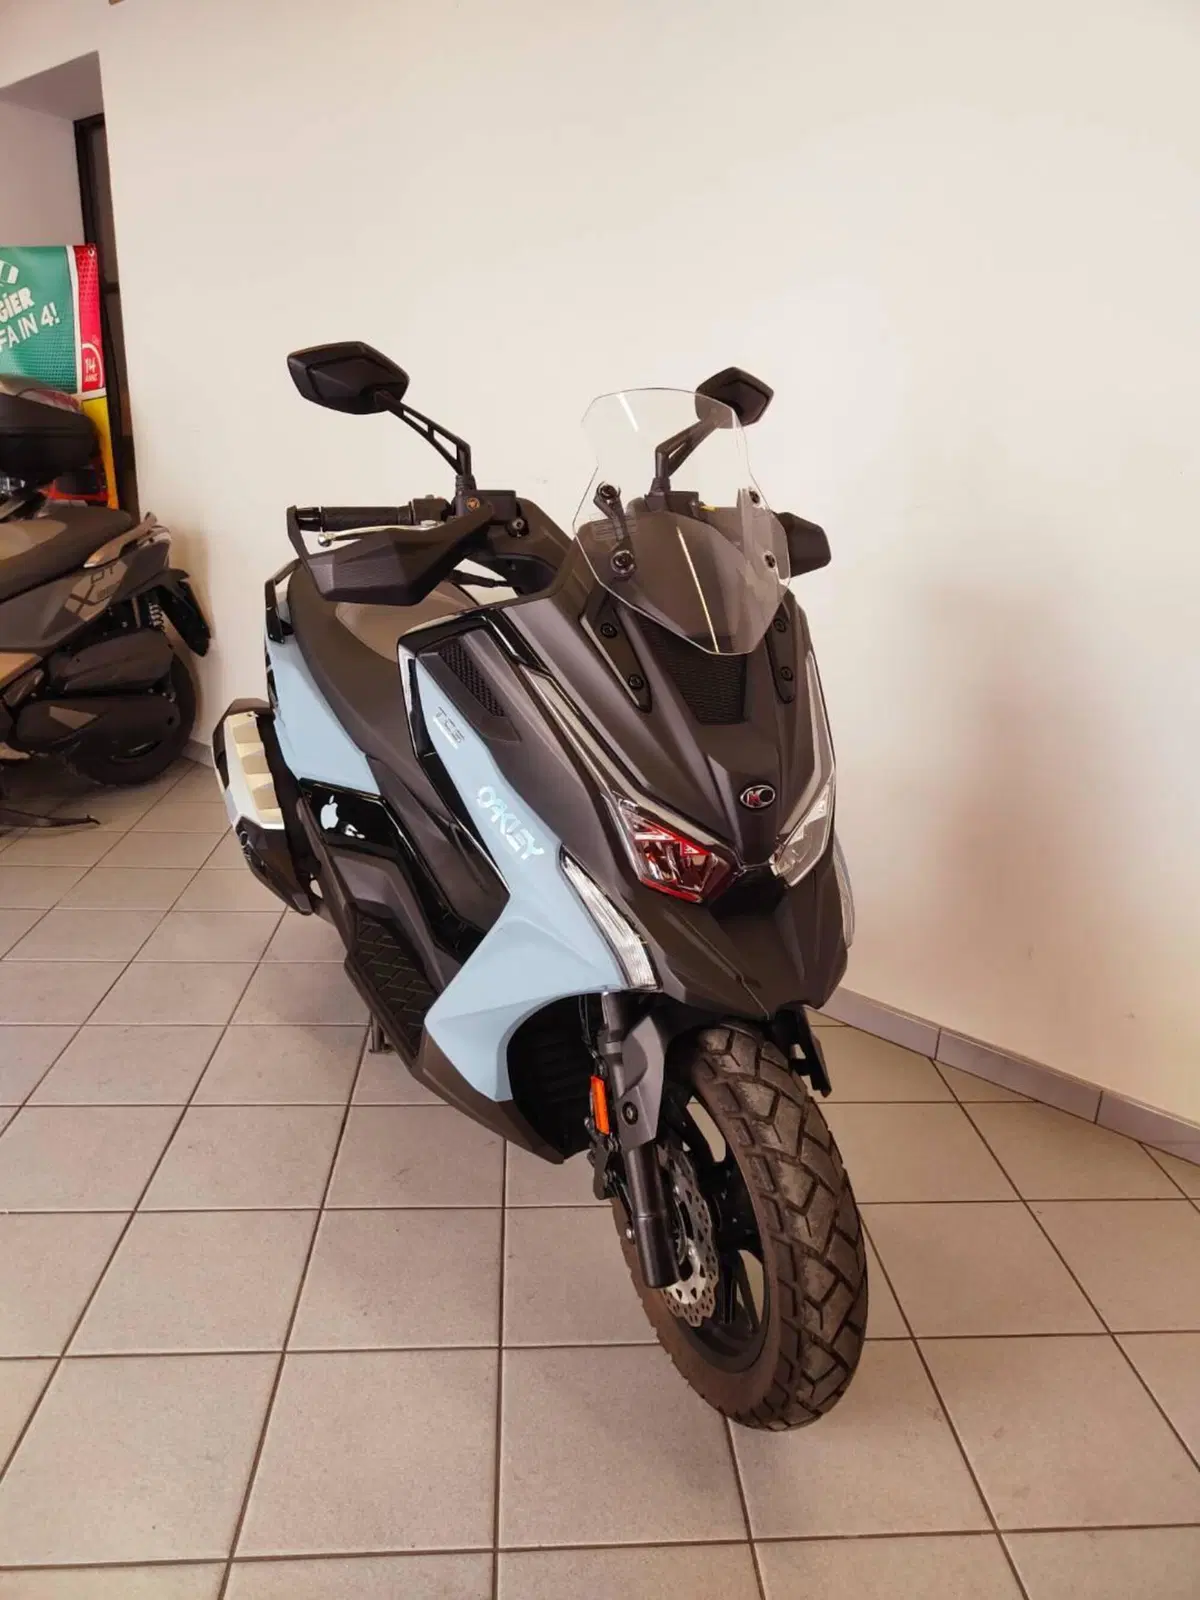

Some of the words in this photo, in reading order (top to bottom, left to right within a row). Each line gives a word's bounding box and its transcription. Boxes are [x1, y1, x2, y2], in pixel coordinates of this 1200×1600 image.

[18, 312, 39, 340] IN
[41, 302, 60, 326] 4!
[476, 786, 545, 860] OAKLEY
